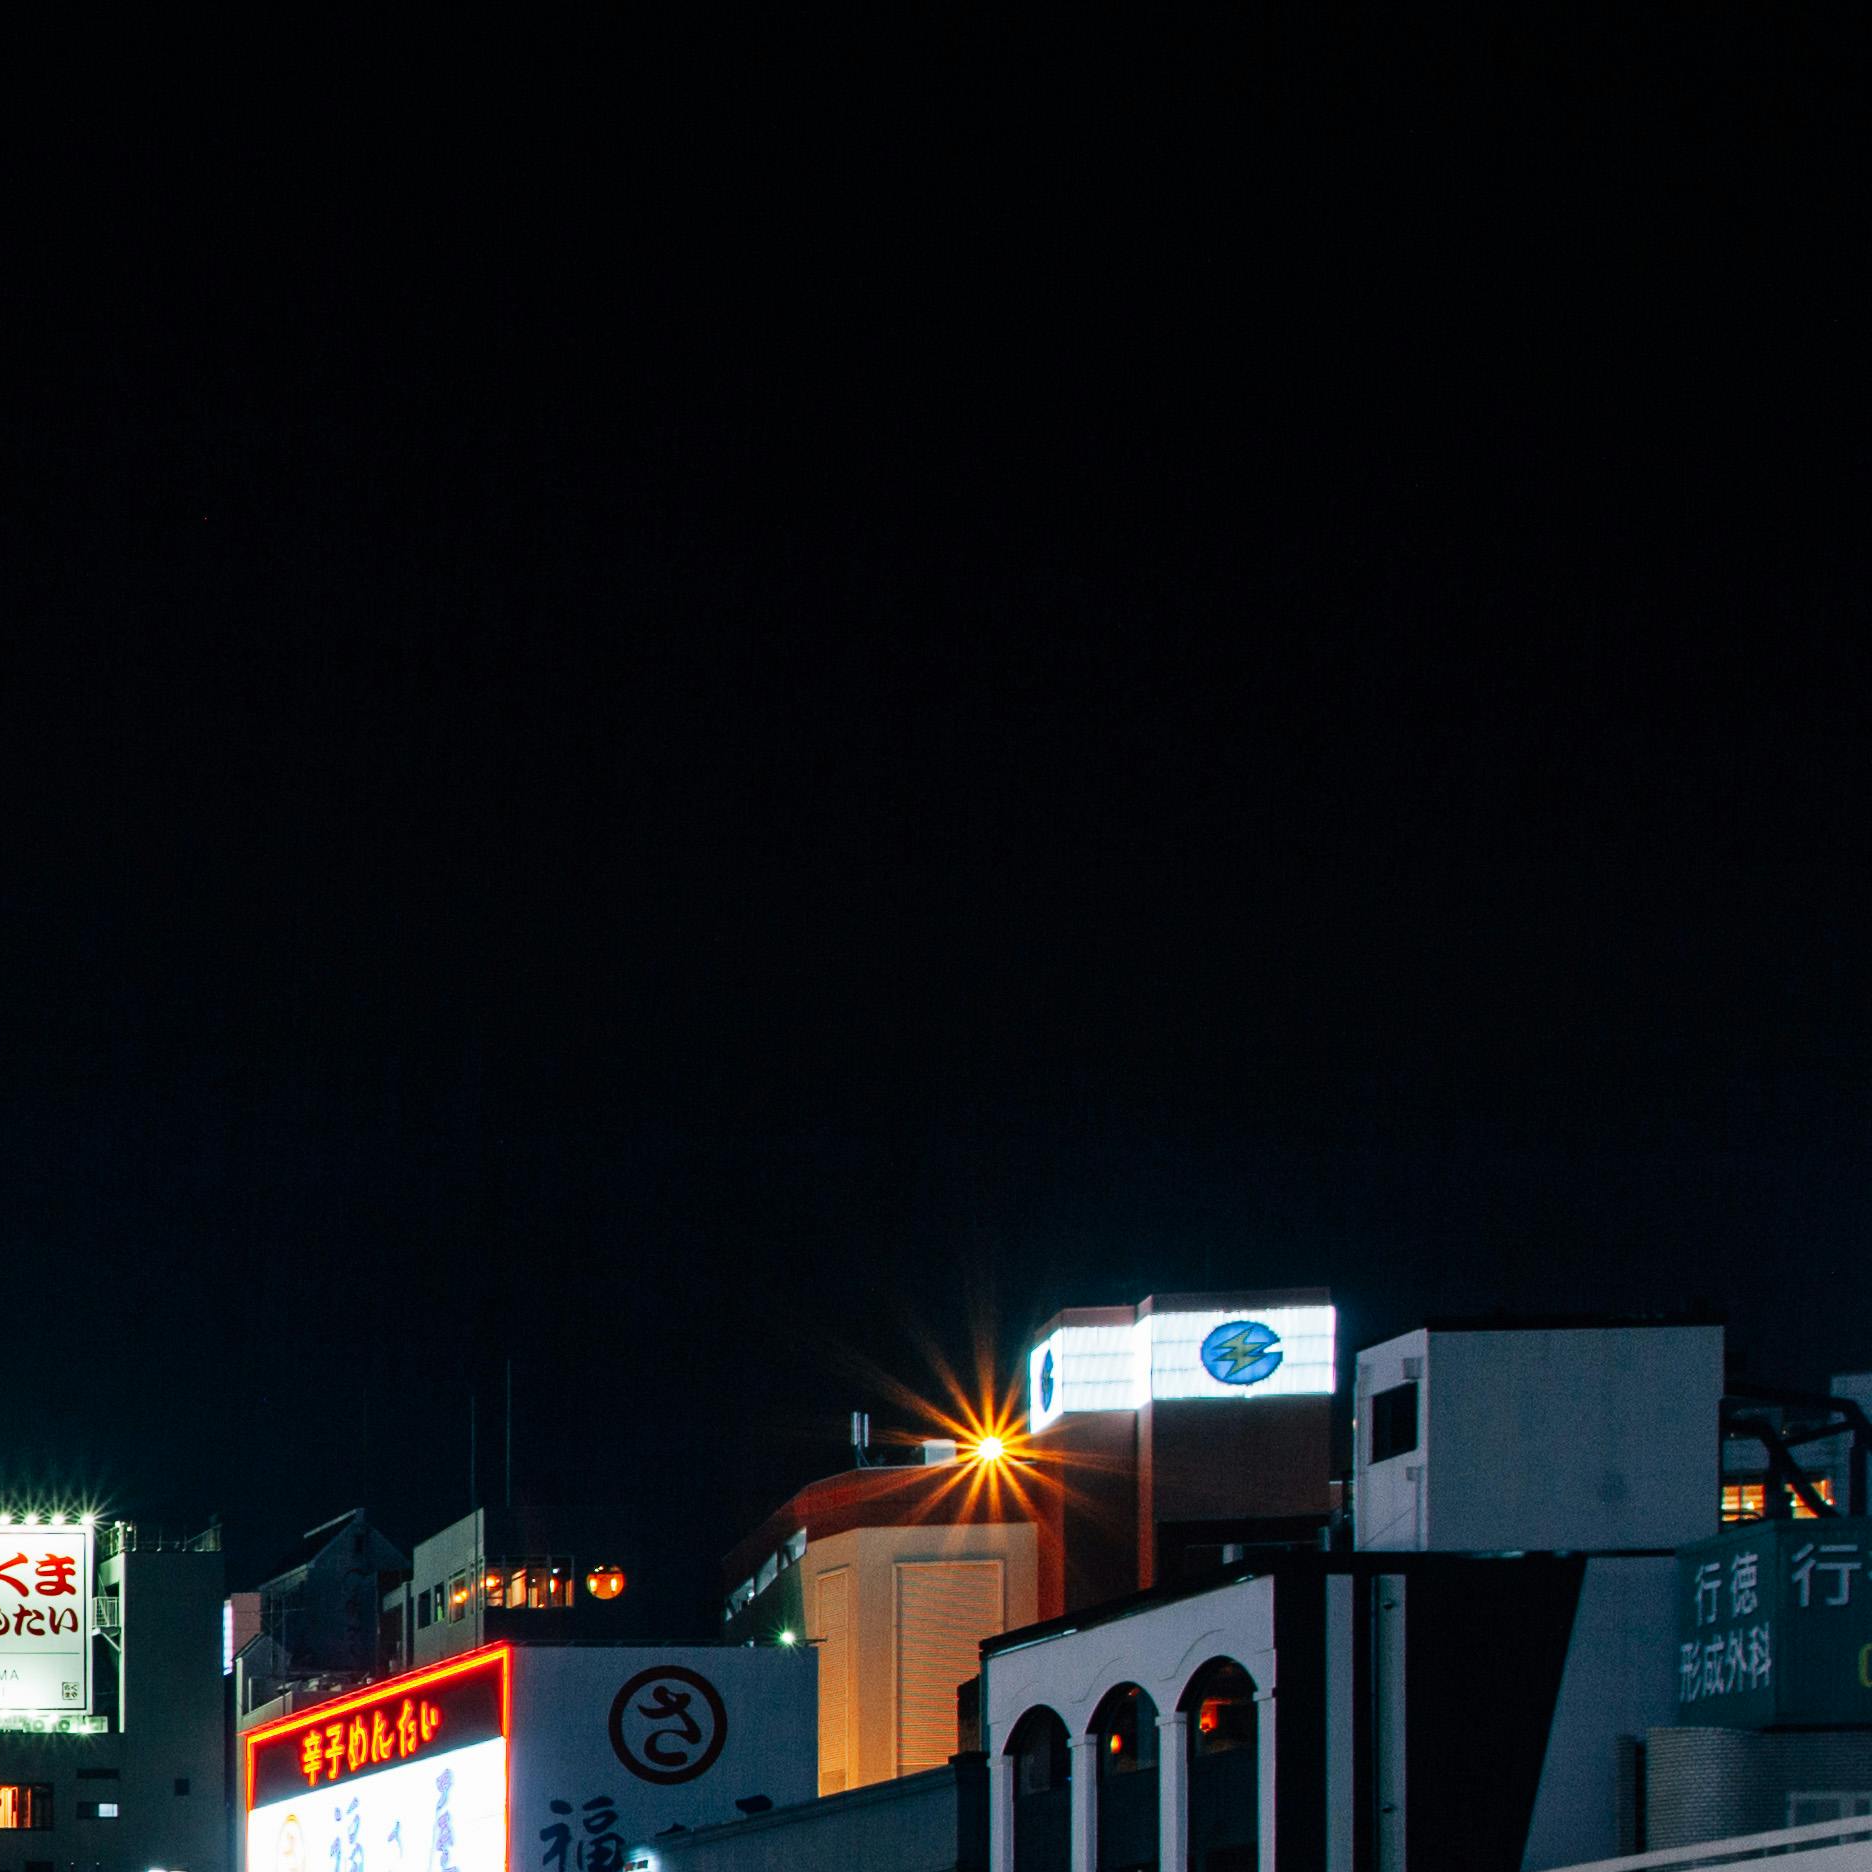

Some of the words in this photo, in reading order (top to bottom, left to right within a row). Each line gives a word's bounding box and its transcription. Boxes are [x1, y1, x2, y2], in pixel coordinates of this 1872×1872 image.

[1694, 1552, 1759, 1627] 行徳
[1791, 1542, 1872, 1608] 行
[1679, 1622, 1772, 1703] 形成外科
[301, 1698, 443, 1788] 辛子めんたい
